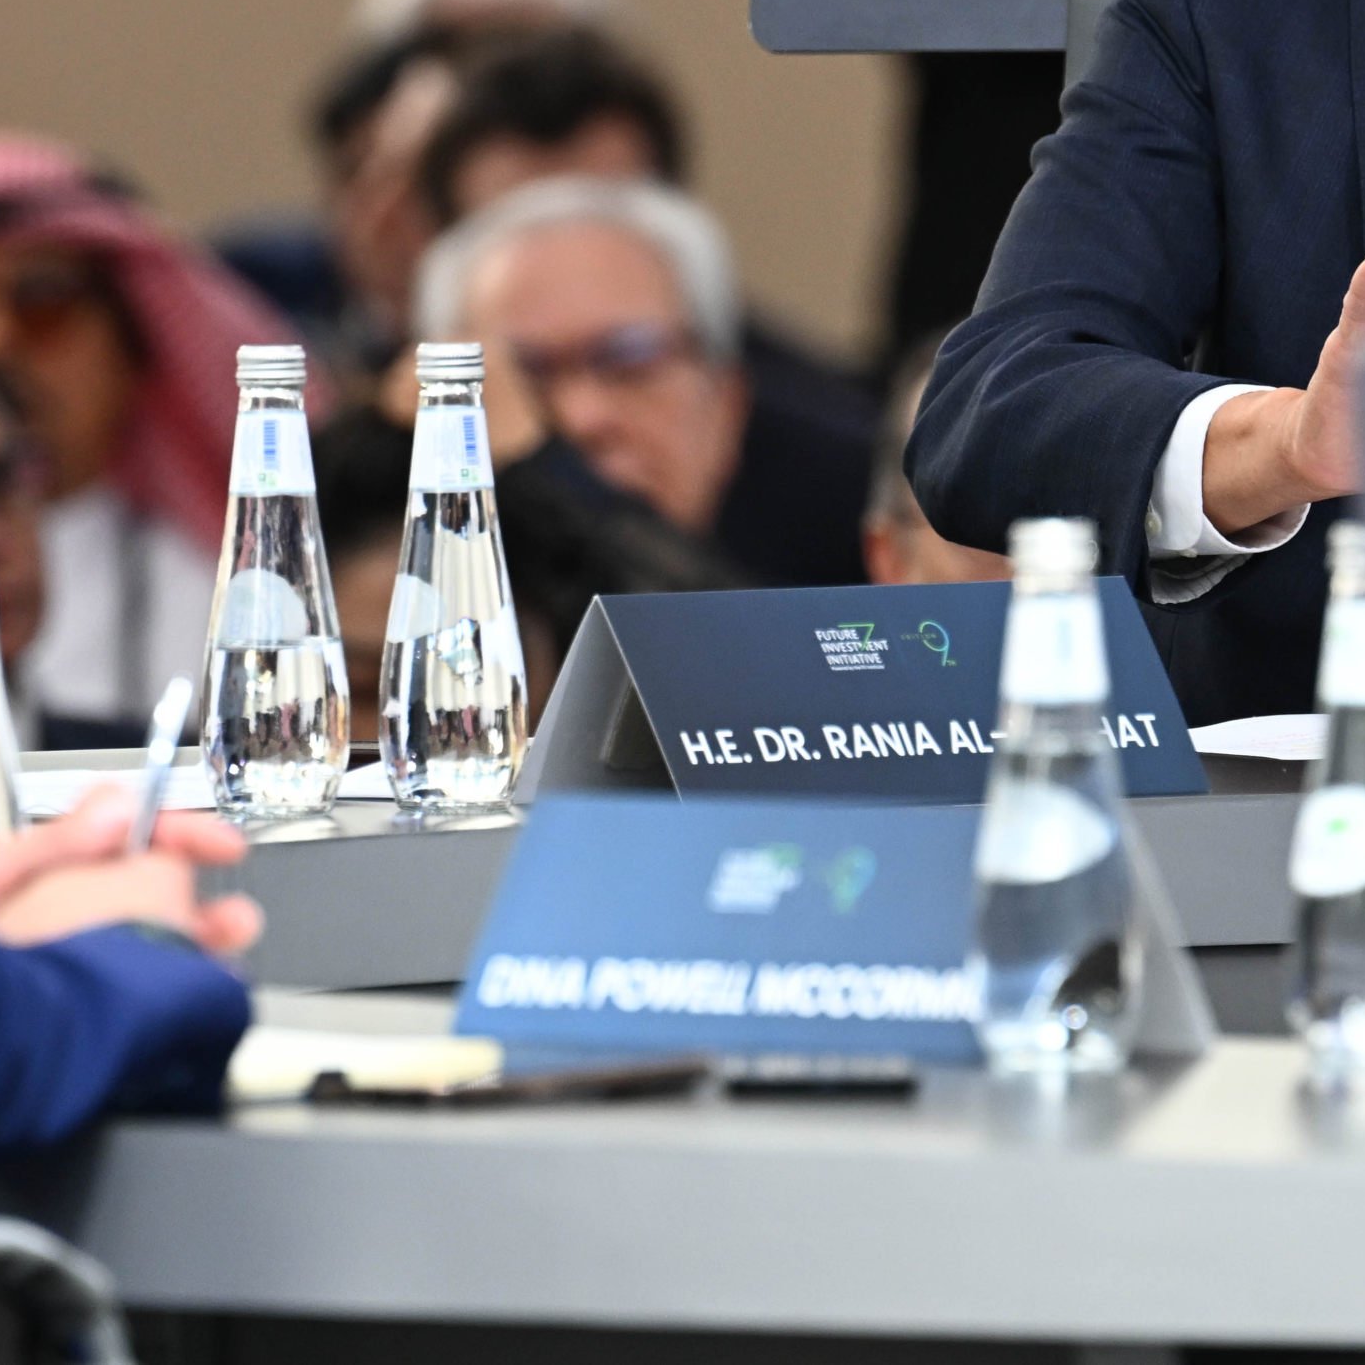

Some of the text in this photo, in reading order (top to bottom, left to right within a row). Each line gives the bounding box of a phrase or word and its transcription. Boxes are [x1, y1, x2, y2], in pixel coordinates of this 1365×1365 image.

[814, 629, 860, 642] FUTURE
[825, 653, 884, 666] INITIATIVE
[680, 730, 753, 766] H.E.
[753, 726, 822, 763] DR.
[822, 720, 943, 760] RANIA
